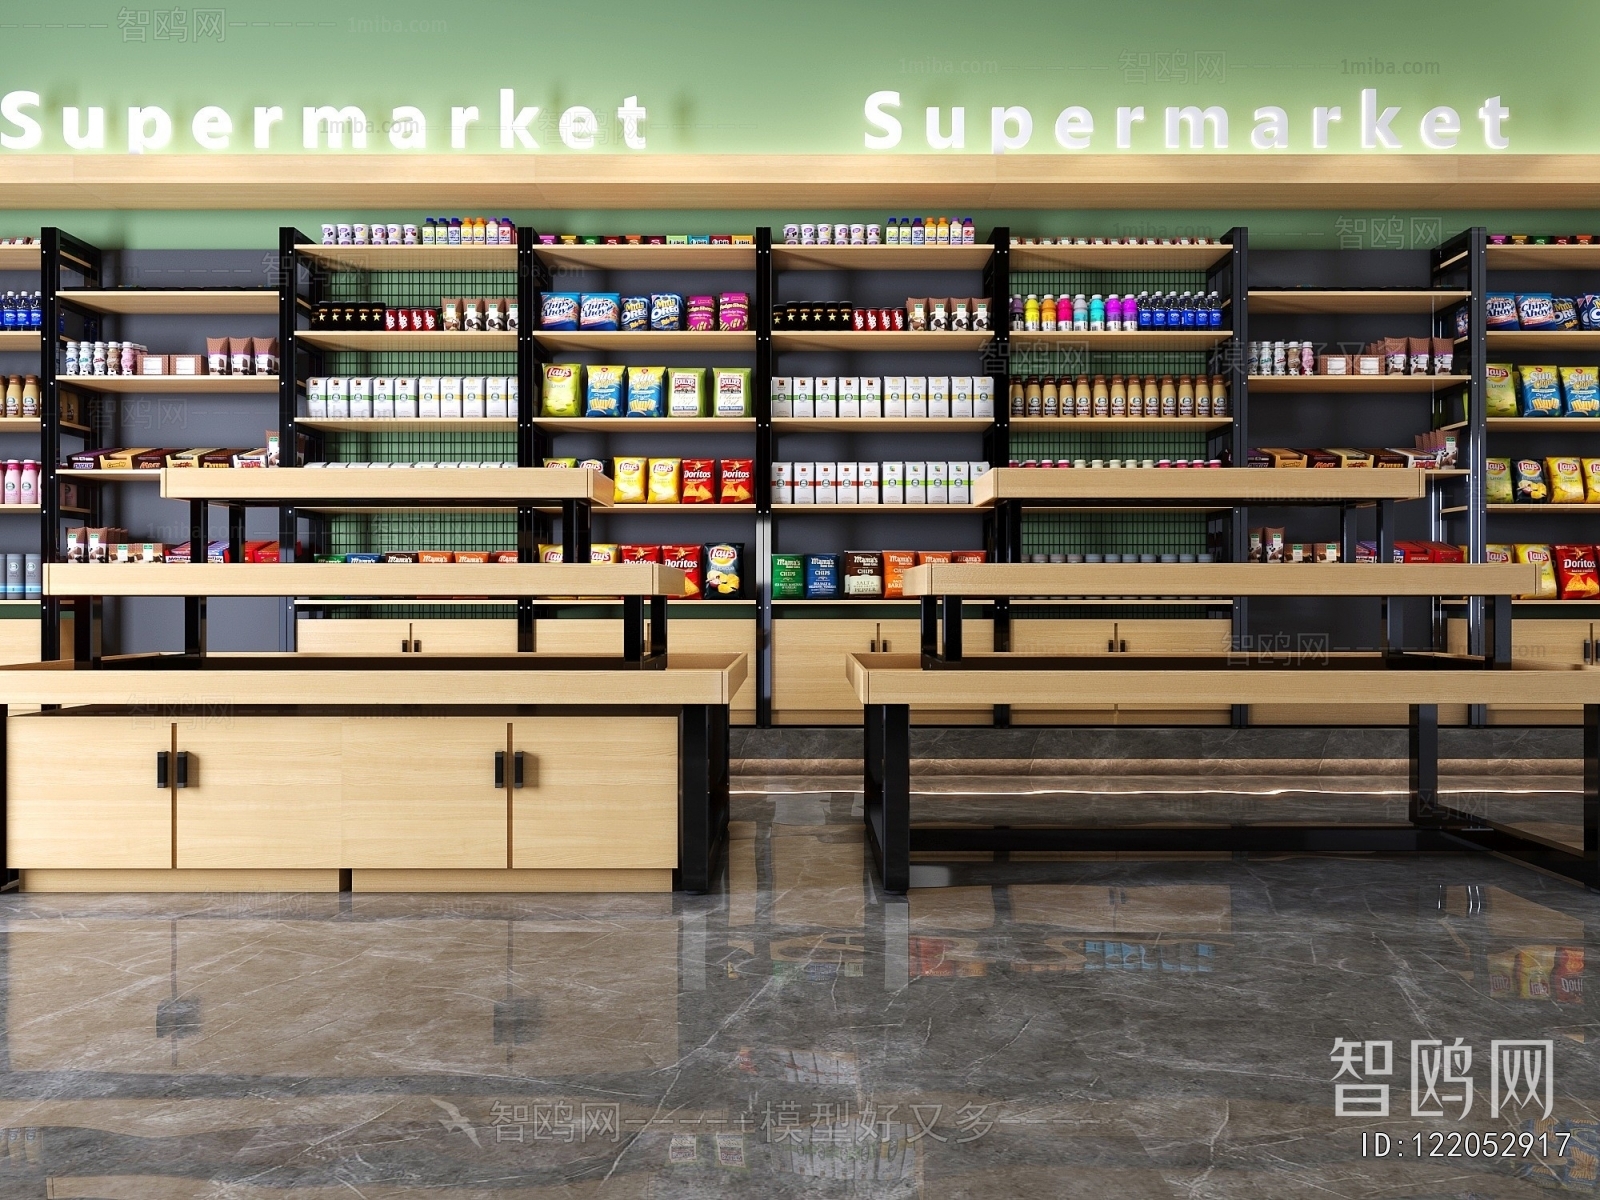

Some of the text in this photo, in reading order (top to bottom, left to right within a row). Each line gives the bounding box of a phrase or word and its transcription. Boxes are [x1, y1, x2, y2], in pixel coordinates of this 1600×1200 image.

[0, 87, 648, 154] Supermarket
[864, 87, 1510, 154] Supermarket
[621, 308, 647, 322] OREO
[651, 306, 679, 318] OREO
[1530, 371, 1553, 383] Sun
[1569, 372, 1593, 385] Sun
[684, 470, 711, 479] Doritos
[722, 470, 750, 479] Doritos
[710, 547, 736, 559] Lay's
[664, 558, 698, 568] Doritos
[777, 558, 801, 566] Mama's
[811, 557, 834, 565] Mama's
[854, 555, 879, 564] Mama's
[889, 555, 913, 564] Mama's
[1564, 558, 1596, 569] Doritos
